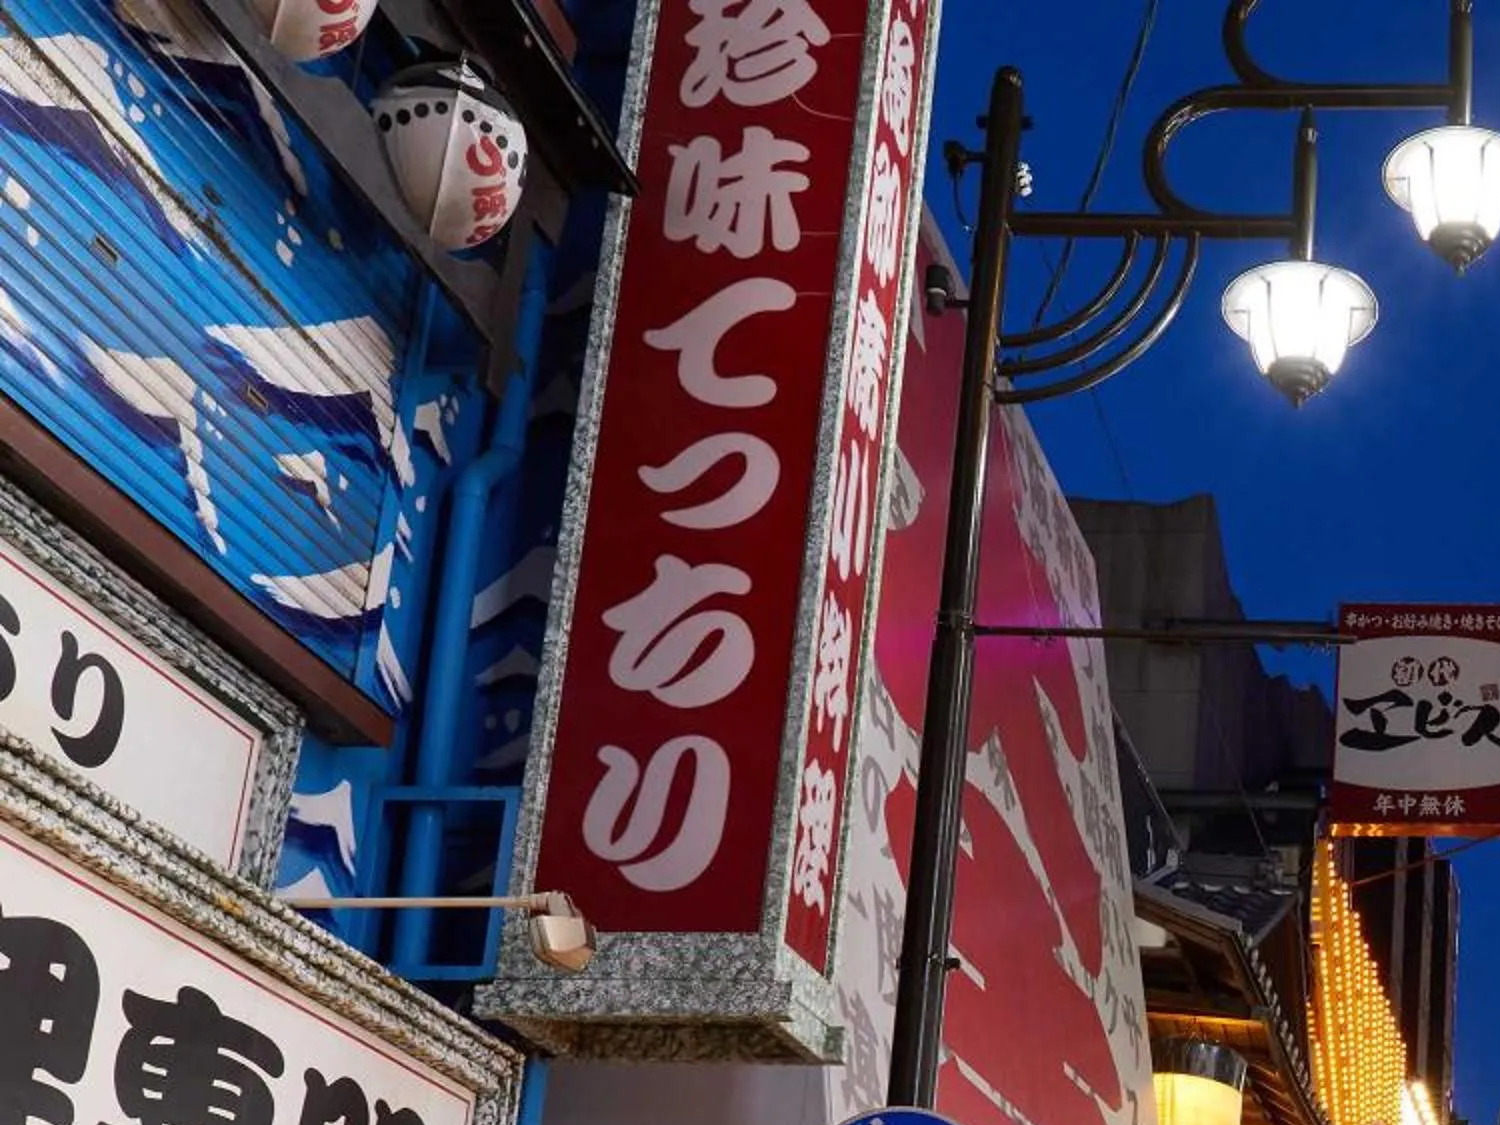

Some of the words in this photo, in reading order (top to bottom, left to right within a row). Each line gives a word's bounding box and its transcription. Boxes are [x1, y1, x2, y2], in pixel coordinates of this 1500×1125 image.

[0, 612, 126, 768] り
[1373, 793, 1467, 816] 年中無休
